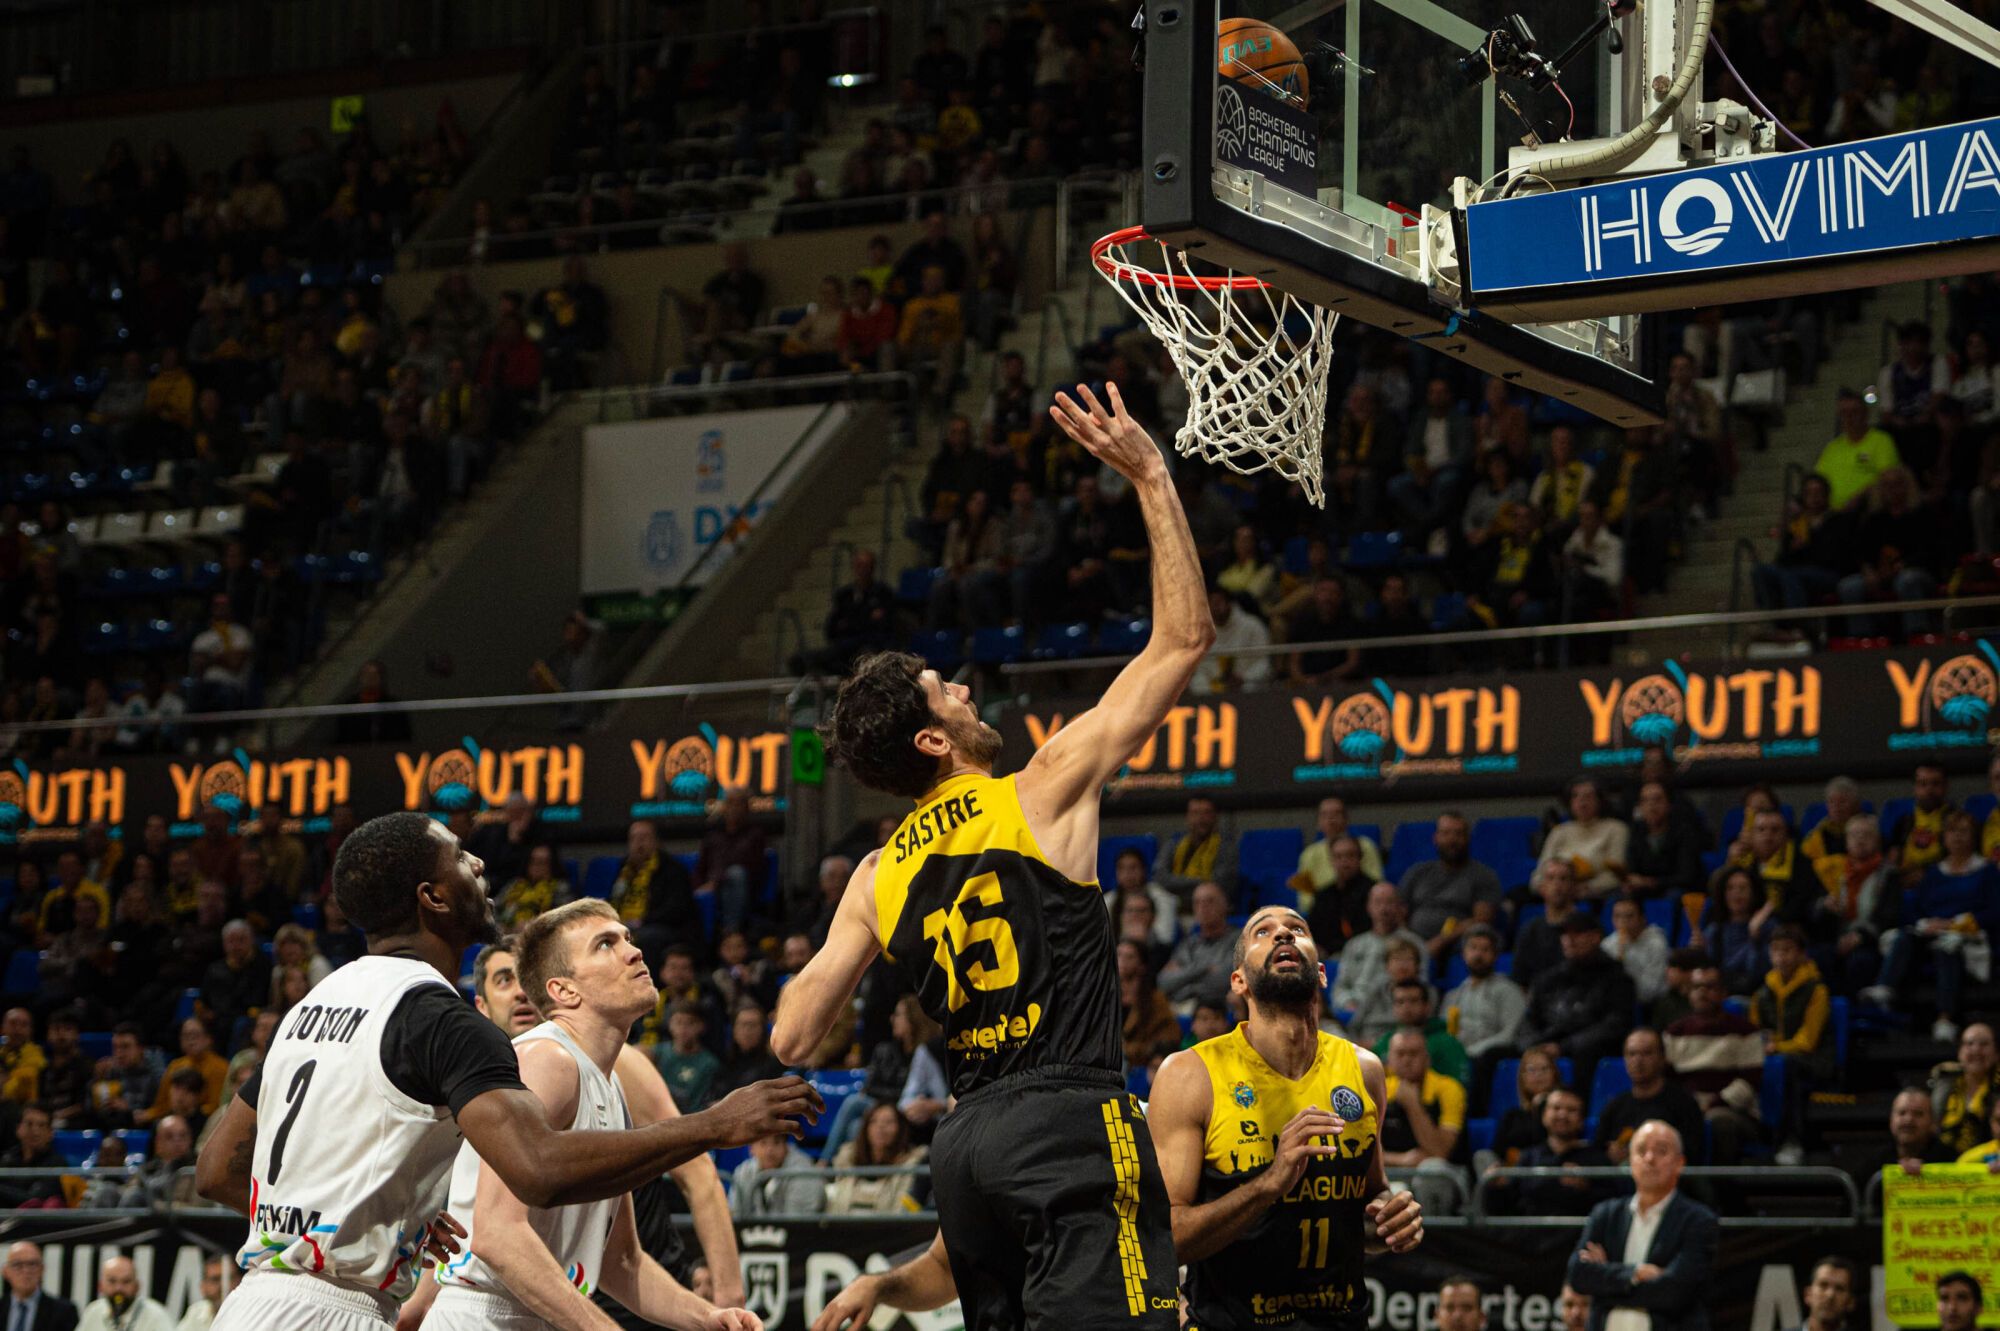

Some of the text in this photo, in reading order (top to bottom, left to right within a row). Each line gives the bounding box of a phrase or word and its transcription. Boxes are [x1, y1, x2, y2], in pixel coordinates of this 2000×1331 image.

[1248, 106, 1308, 146] BASKETBALL
[1248, 124, 1316, 168] CHAMPIONS
[1248, 144, 1285, 172] LEAGUE
[1581, 129, 2000, 271] HOVIMA
[1292, 684, 1521, 761] YOUTH
[1578, 665, 1822, 746] YOUTH
[168, 754, 351, 821] YOUTH
[394, 742, 586, 811] YOUTH
[630, 731, 790, 800] YOUT
[895, 789, 983, 864] SASTRE
[923, 870, 1020, 1014] 15
[285, 1004, 369, 1043] DOTSON
[1297, 1217, 1330, 1269] 11
[1151, 1296, 1179, 1310] Can
[1364, 1277, 1570, 1331] Deprtes
